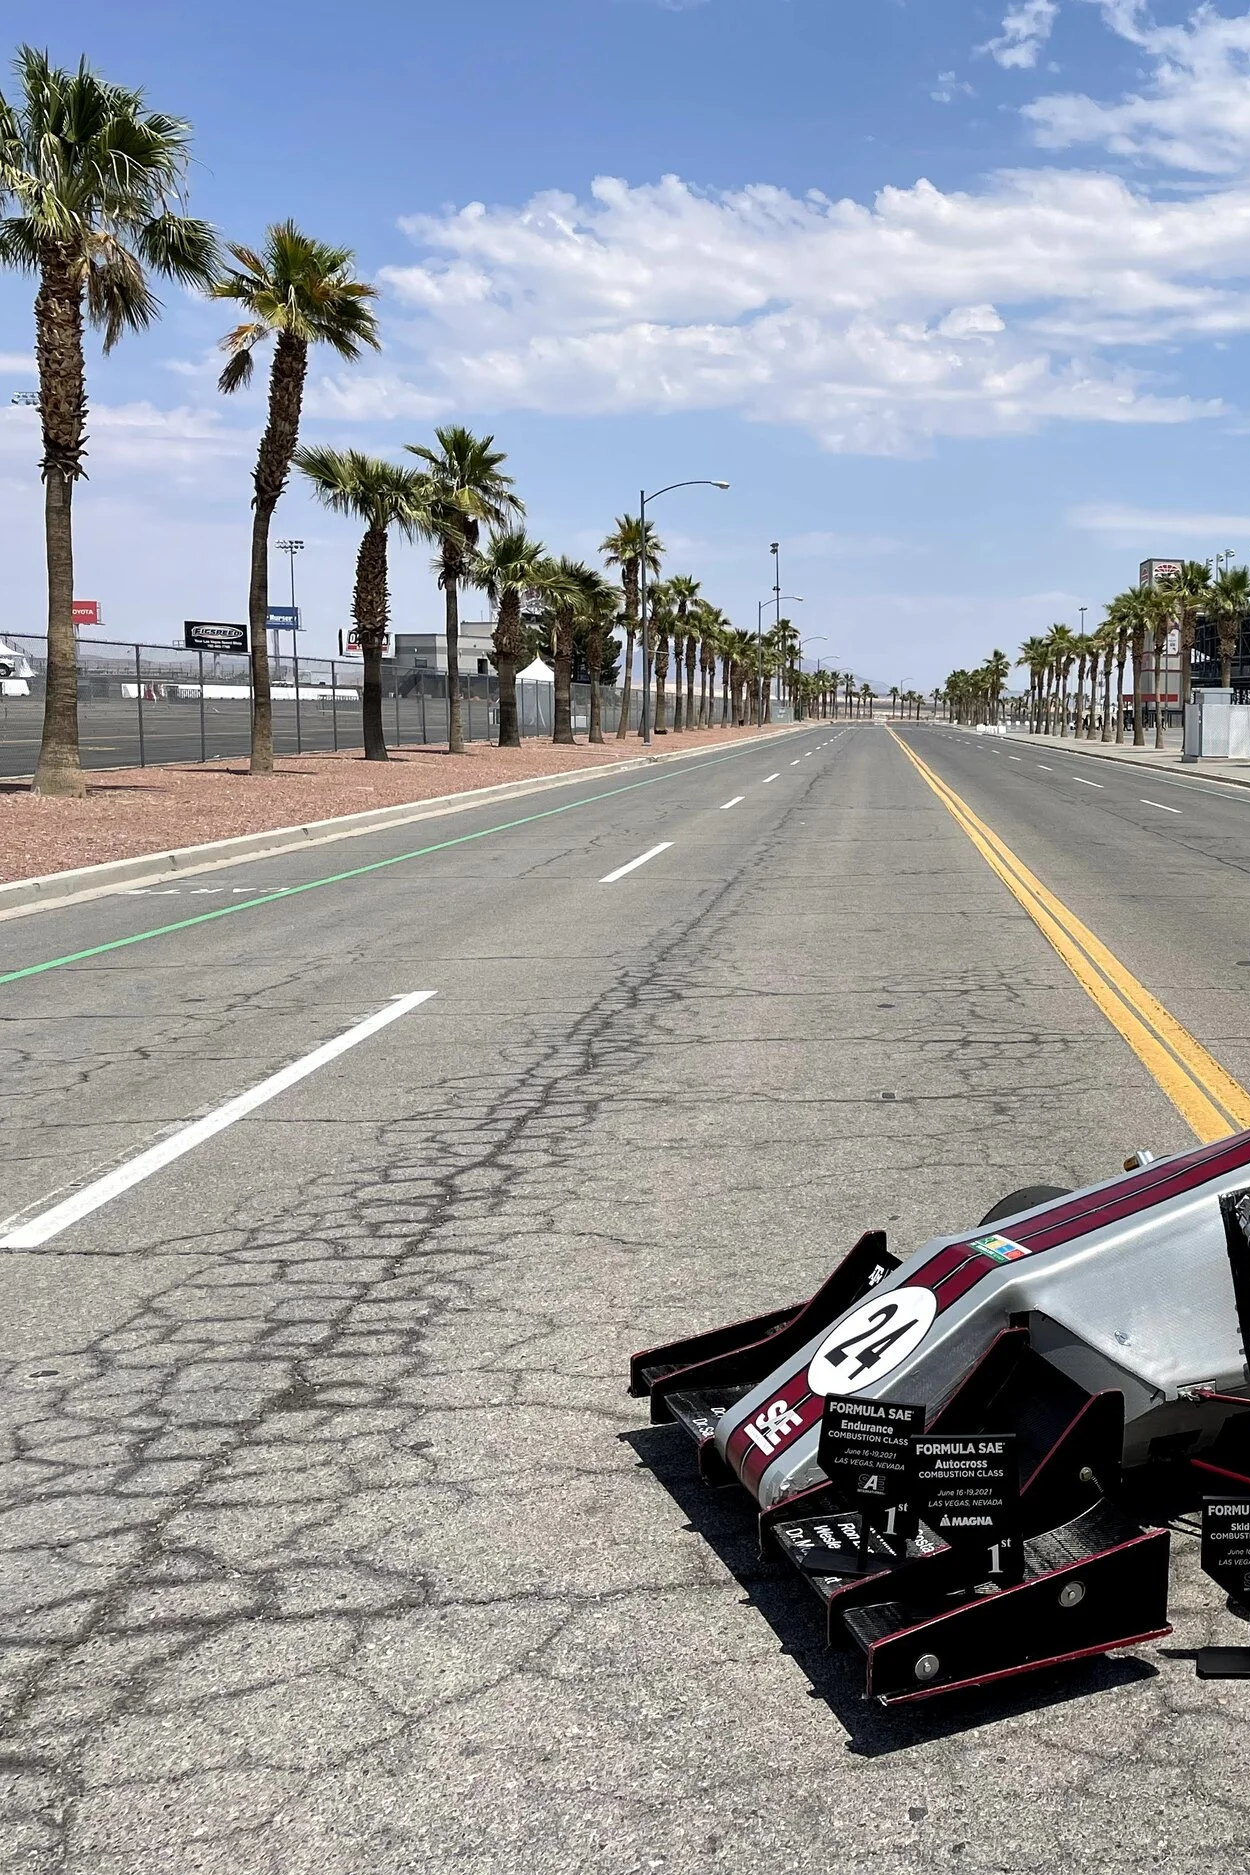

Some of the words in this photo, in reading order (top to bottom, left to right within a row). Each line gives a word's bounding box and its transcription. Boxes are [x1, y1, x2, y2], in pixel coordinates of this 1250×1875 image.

[825, 1303, 919, 1381] 24
[829, 1402, 886, 1419] FORMULA
[888, 1408, 913, 1421] SAE
[841, 1419, 894, 1435] Endurance
[828, 1430, 882, 1443] COMBUSTION
[883, 1436, 909, 1446] CLASS
[916, 1443, 976, 1455] FORMULA
[978, 1442, 1004, 1453] SAE
[875, 1461, 905, 1471] NEVADA
[935, 1459, 988, 1470] Autocross
[976, 1469, 1004, 1477] CLASS
[882, 1502, 909, 1536] 1st
[951, 1516, 993, 1526] MAGNA
[1230, 1522, 1250, 1531] Skid
[813, 1524, 841, 1550] Wesle
[987, 1537, 1012, 1574] 1st
